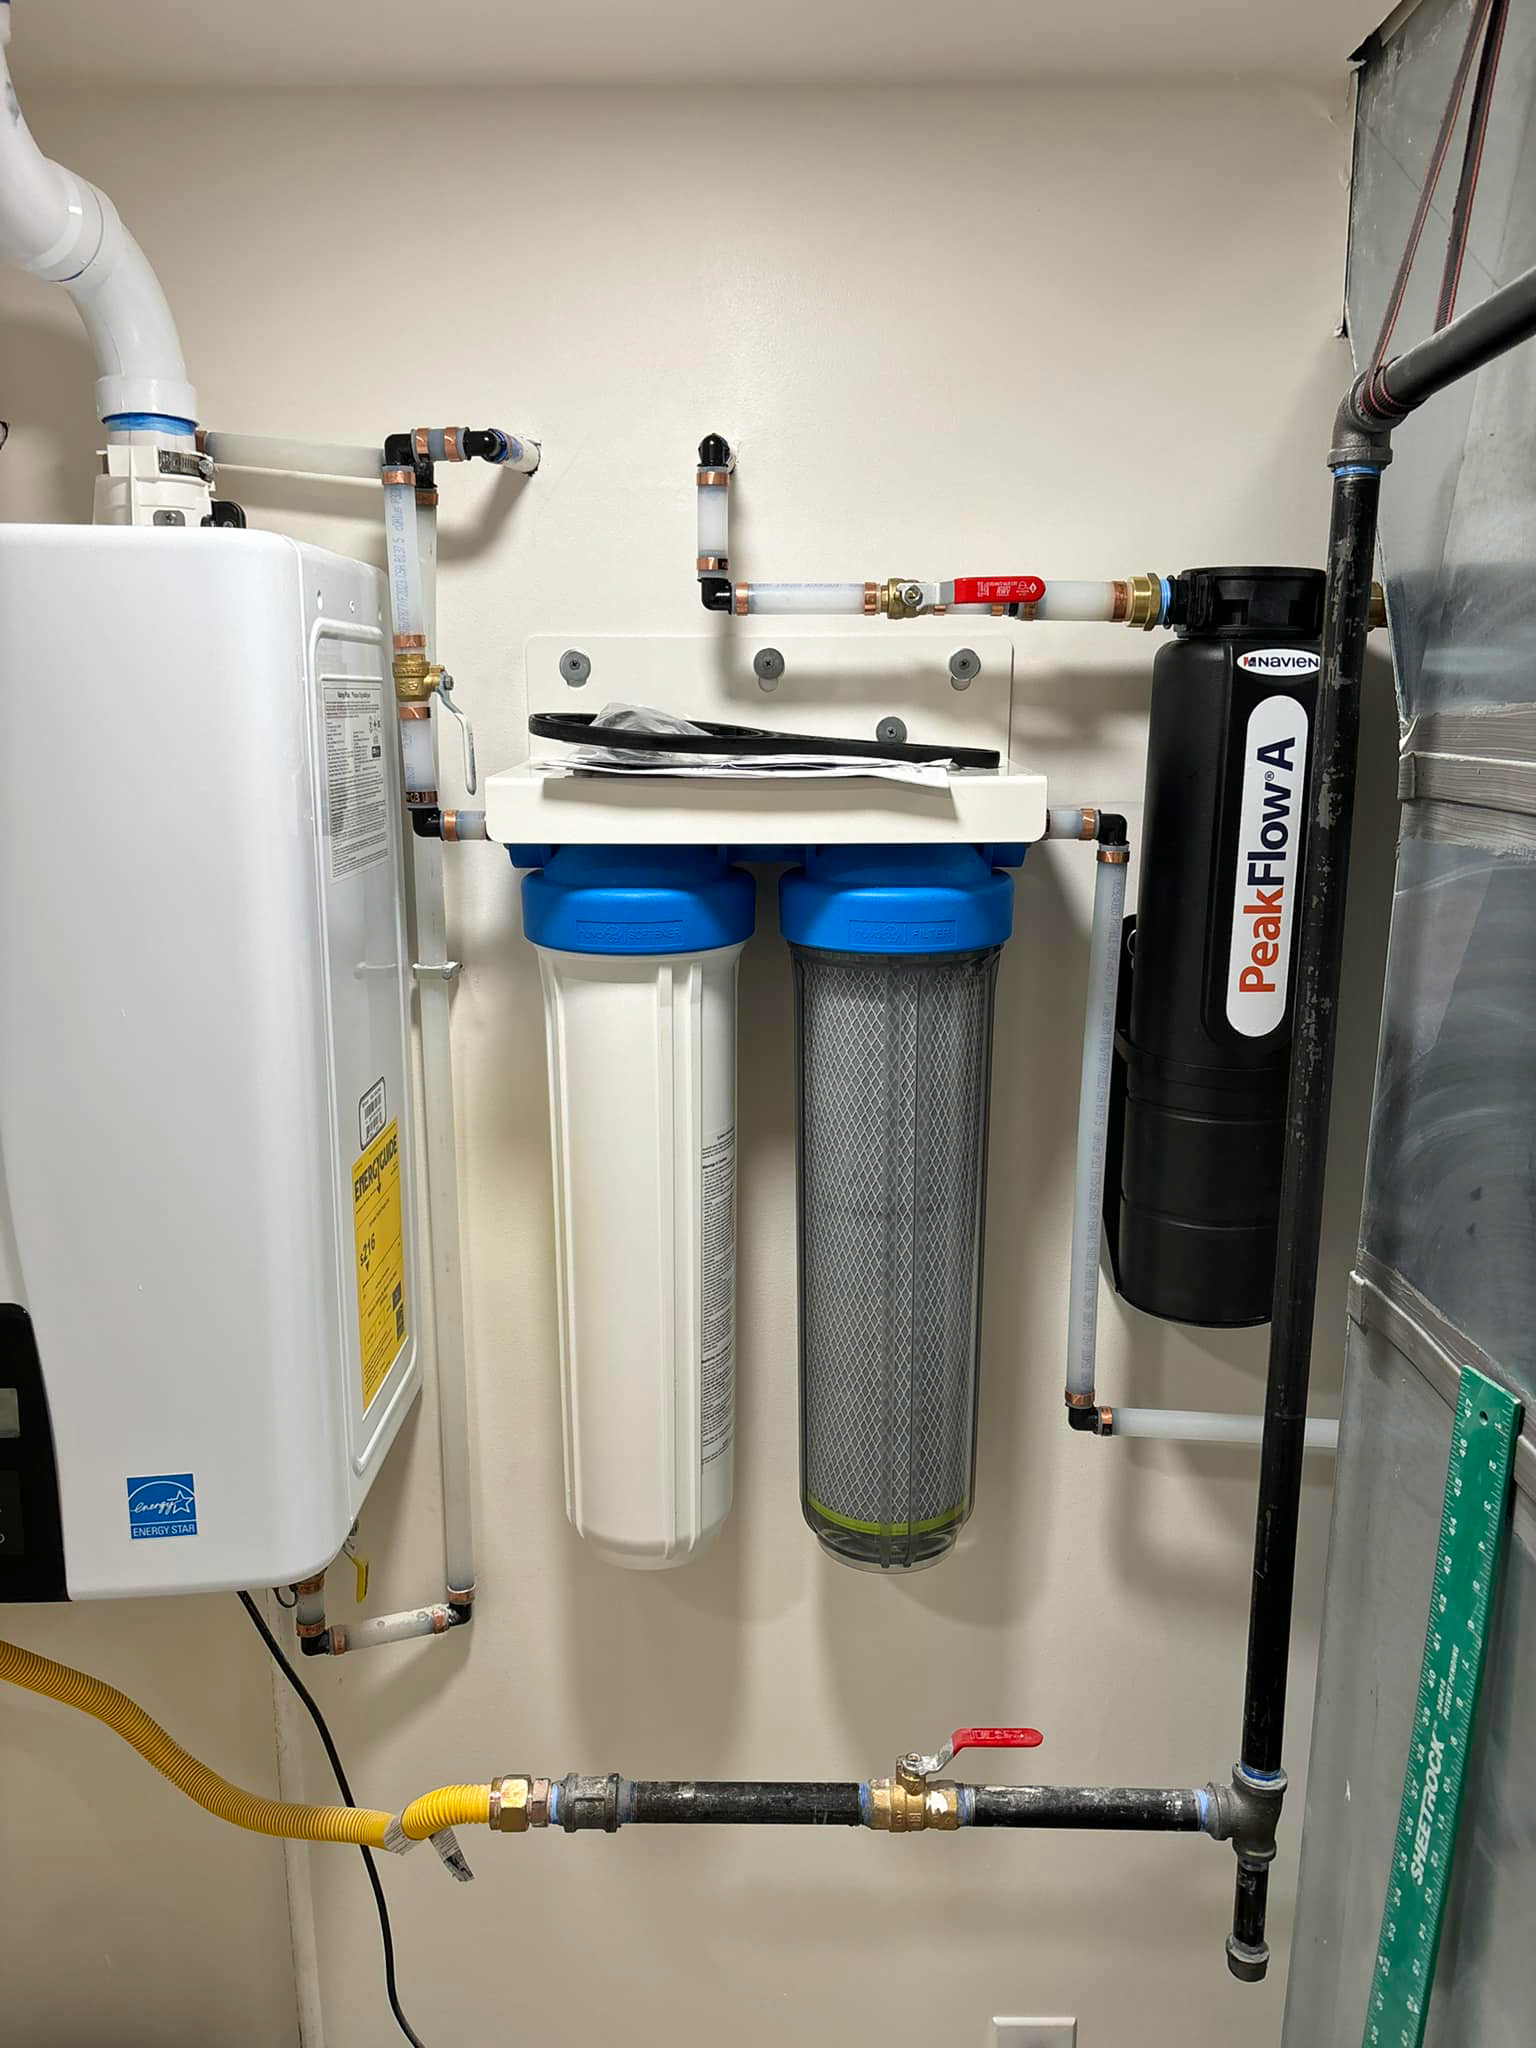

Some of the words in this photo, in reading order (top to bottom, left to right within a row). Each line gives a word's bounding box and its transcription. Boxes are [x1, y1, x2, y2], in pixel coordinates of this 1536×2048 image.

[1256, 735, 1297, 771] A
[1464, 1398, 1472, 1418] 47
[1459, 1437, 1467, 1457] 46
[1488, 1459, 1497, 1471] 2
[1454, 1477, 1463, 1496] 45
[1483, 1500, 1492, 1512] 3
[132, 1525, 170, 1537] ENERGY
[171, 1523, 196, 1535] STAR
[1449, 1516, 1457, 1536] 44
[1478, 1540, 1486, 1551] 4
[1444, 1555, 1452, 1575] 43
[1433, 1632, 1442, 1651] 41
[1461, 1659, 1470, 1670] 7
[1427, 1669, 1437, 1689] 40
[1443, 1776, 1452, 1793] 10
[1411, 1730, 1445, 1886] SHEETROCK
